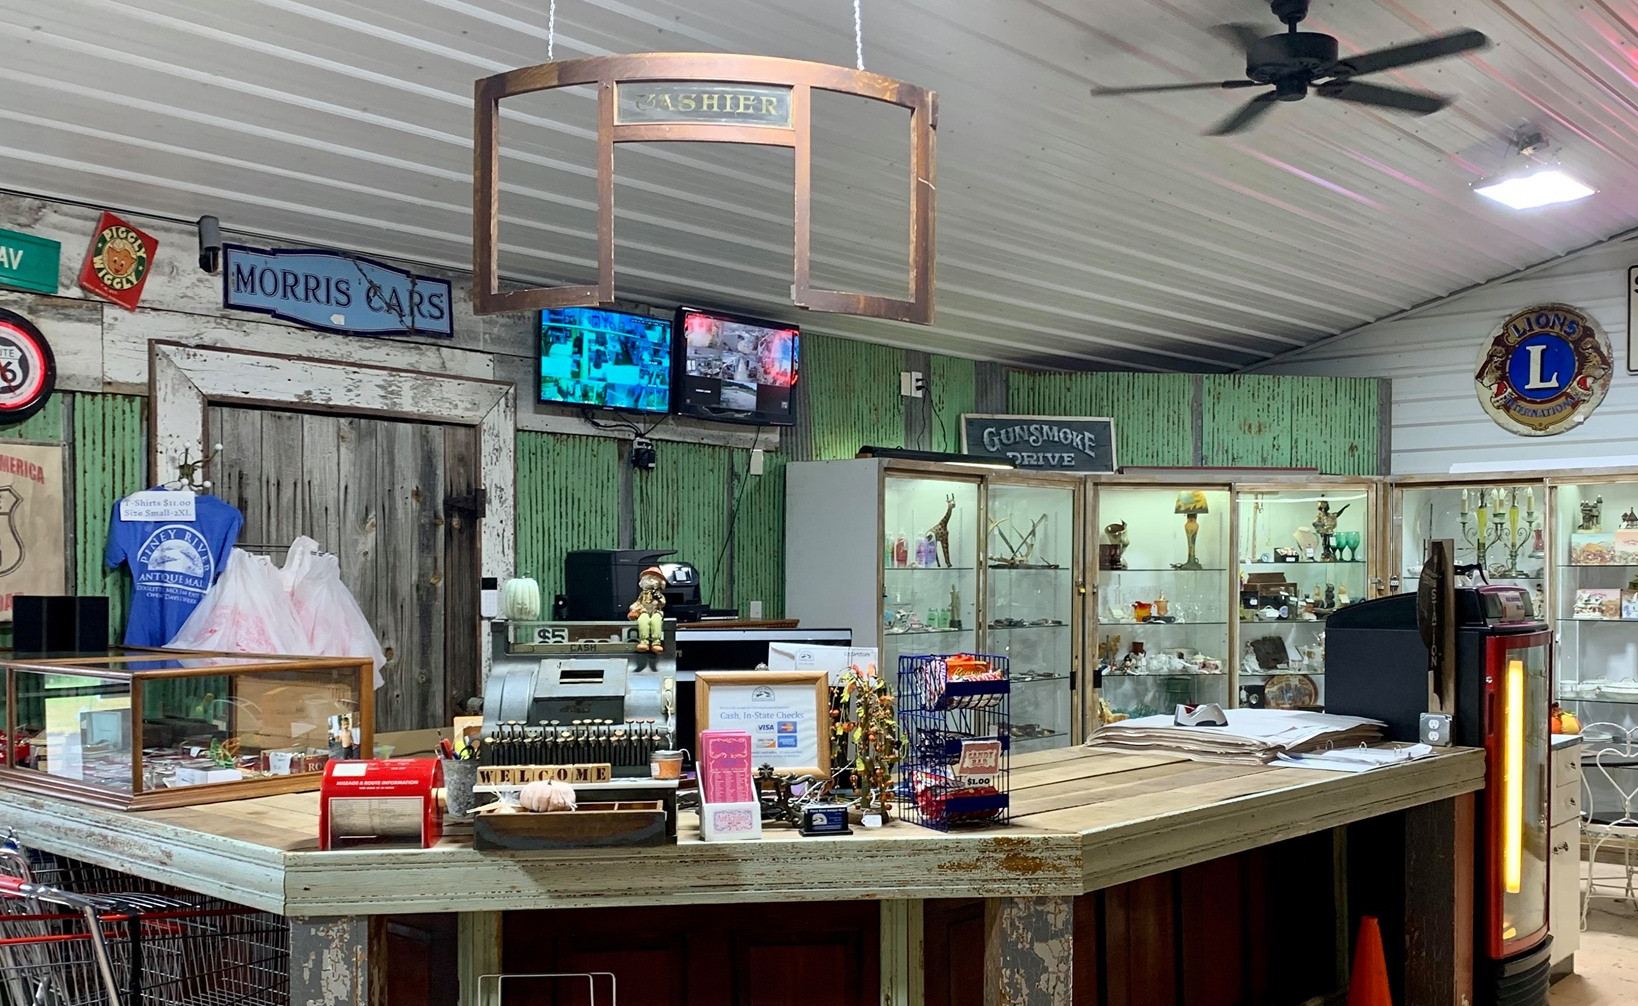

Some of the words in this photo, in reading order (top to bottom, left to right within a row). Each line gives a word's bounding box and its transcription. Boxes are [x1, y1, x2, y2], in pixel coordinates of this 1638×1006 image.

[102, 226, 147, 258] PIGGLY
[93, 254, 138, 290] WIGGLY
[233, 261, 351, 308] MORRIS
[364, 284, 446, 320] CARS
[1510, 311, 1579, 338] LIONS
[1524, 344, 1560, 390] L
[983, 424, 1097, 458] GUNSMOKE
[1006, 452, 1076, 466] DRIVE
[124, 499, 161, 507] T-Shirts
[163, 499, 192, 507] $11.00
[124, 509, 143, 517] Size
[145, 509, 192, 517] Small-2XL
[140, 529, 177, 564] PINEY
[138, 572, 184, 584] ANTQUE
[185, 577, 206, 588] MAL
[569, 643, 597, 652] CASH
[720, 711, 742, 721] Cash,
[743, 711, 775, 720] In-State
[776, 711, 805, 720] Checks
[968, 751, 994, 759] CANDY
[479, 767, 607, 783] WELCOME
[967, 777, 990, 786] $1.00
